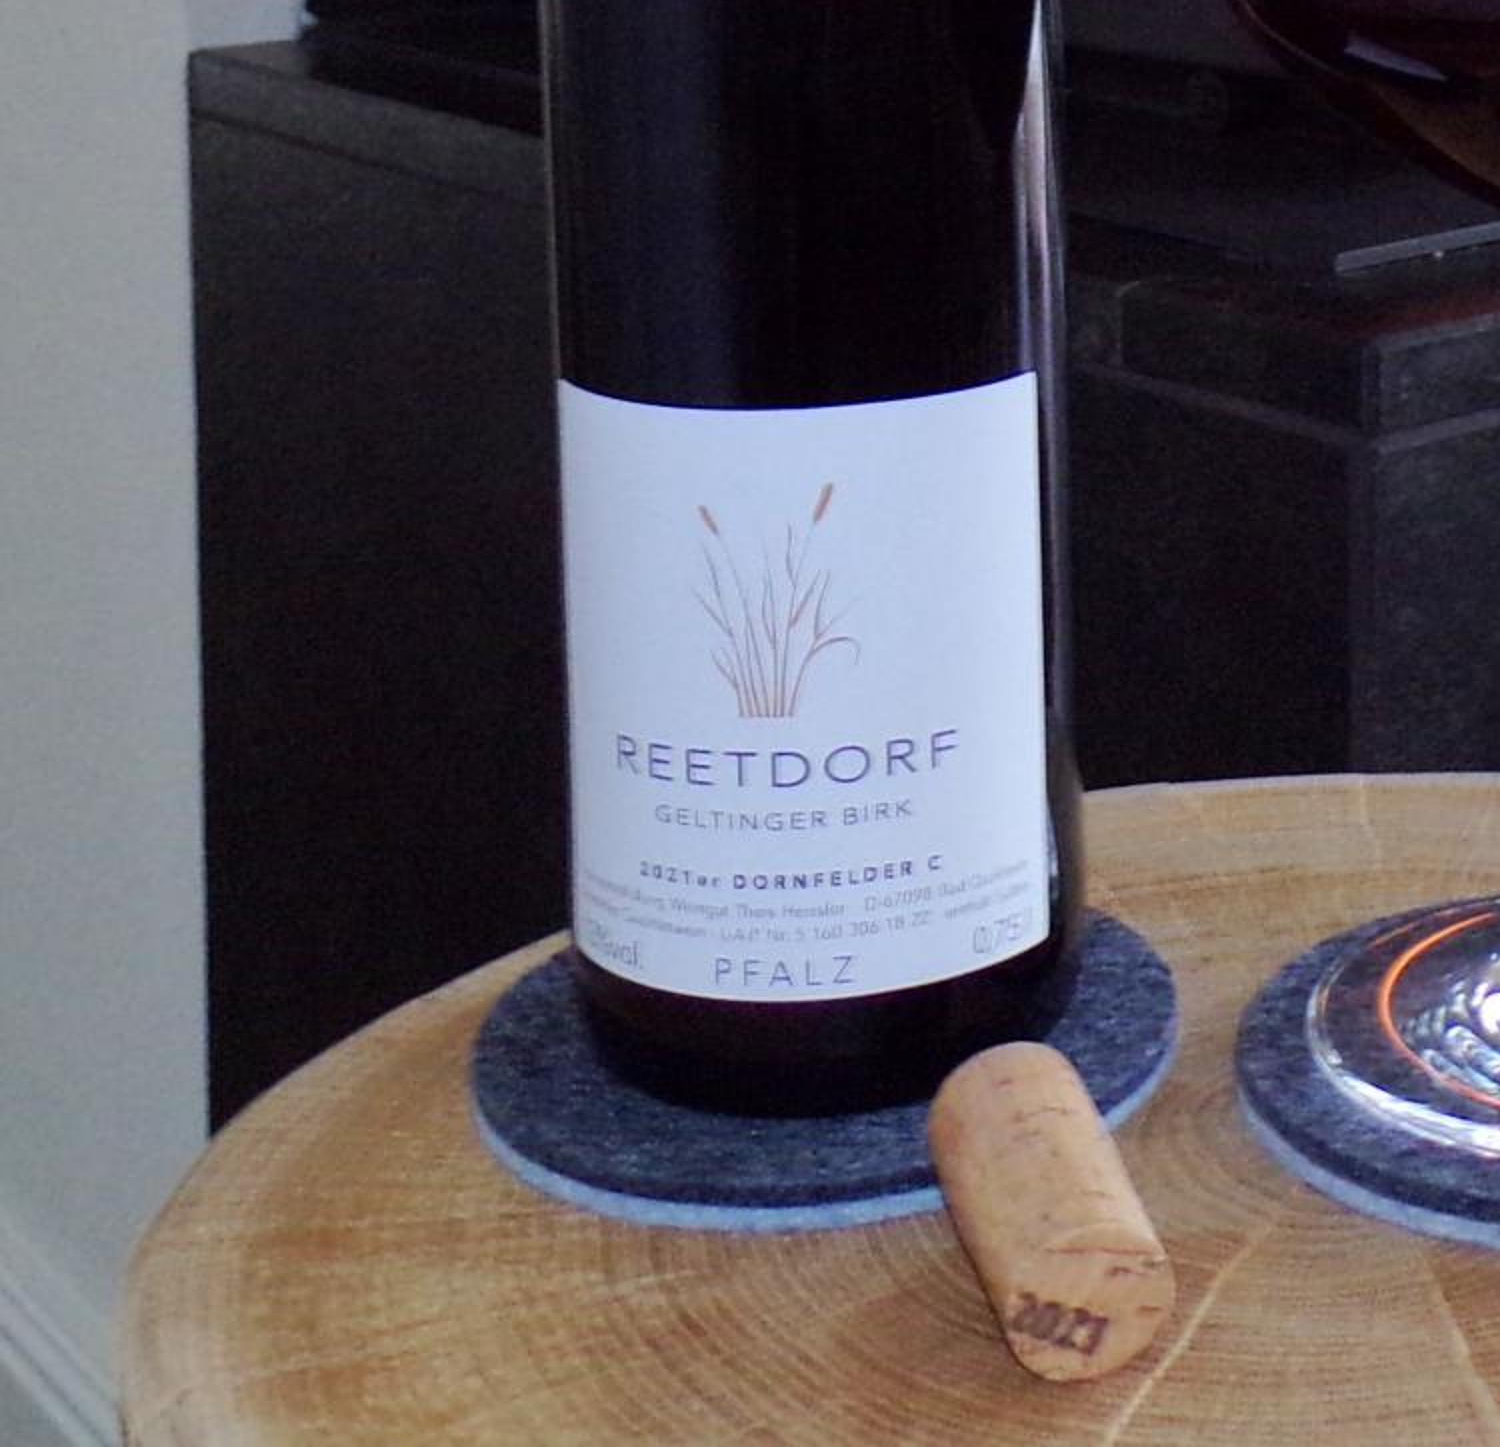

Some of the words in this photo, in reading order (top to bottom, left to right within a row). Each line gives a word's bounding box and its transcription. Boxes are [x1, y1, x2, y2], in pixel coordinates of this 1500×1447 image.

[615, 729, 959, 789] REETDORF
[654, 803, 829, 832] GELTINGER
[842, 798, 912, 826] BIRK
[639, 860, 721, 887] 2021er
[733, 860, 913, 891] DORNFELDER
[927, 854, 942, 871] C
[714, 955, 855, 988] PFALZ
